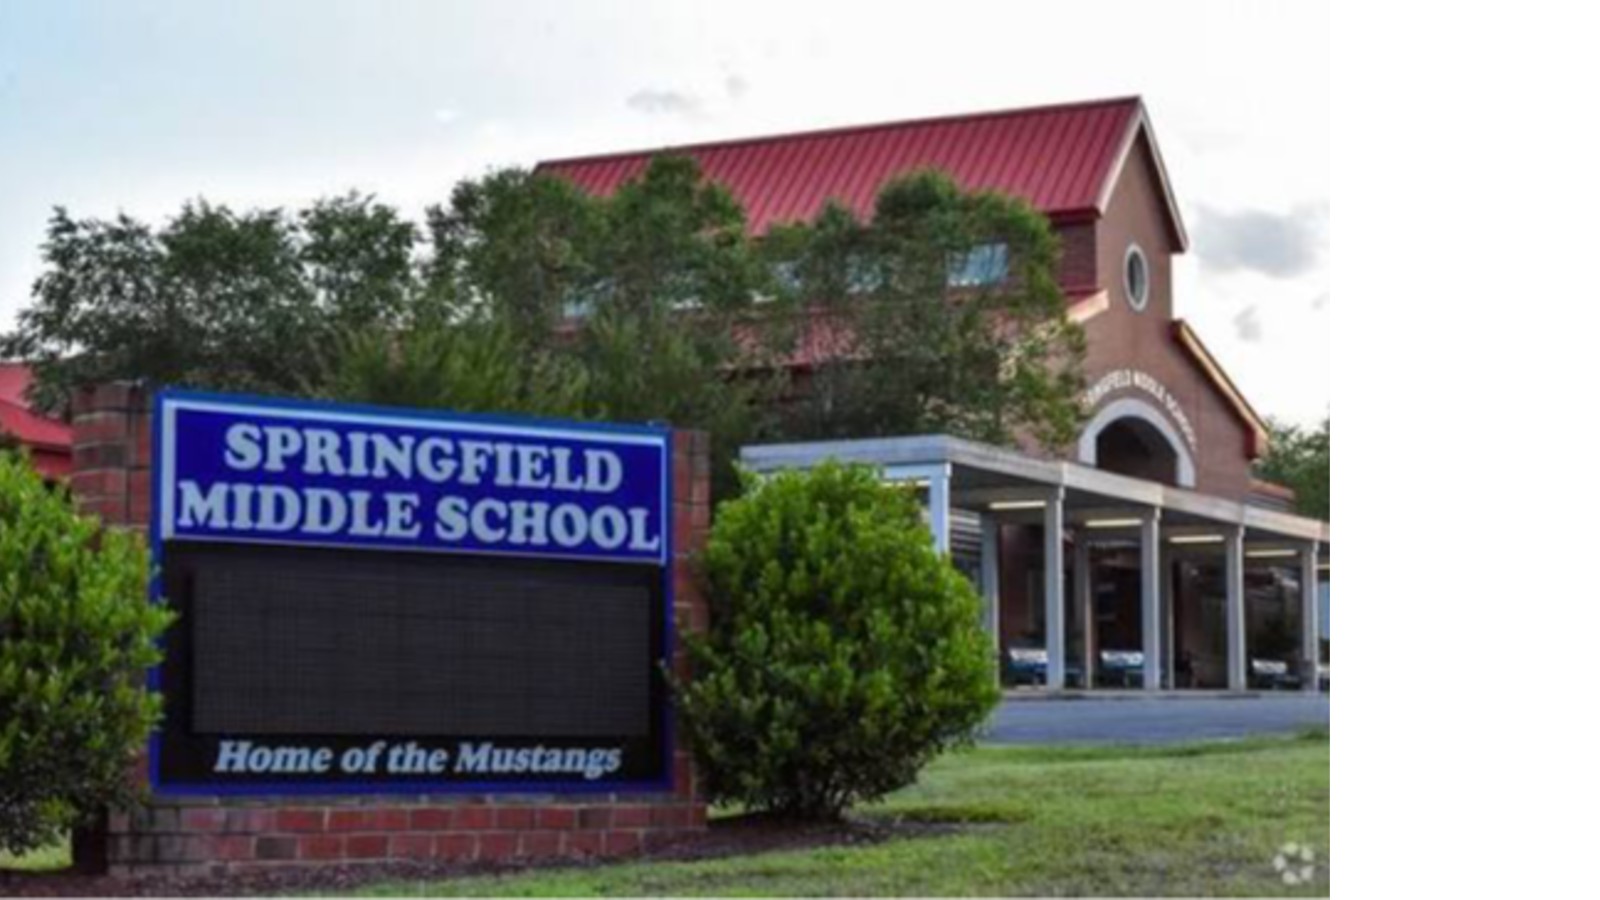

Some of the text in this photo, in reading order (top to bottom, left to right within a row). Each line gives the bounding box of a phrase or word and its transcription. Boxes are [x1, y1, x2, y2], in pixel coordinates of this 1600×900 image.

[224, 423, 623, 493] SPRINGFIELD
[177, 480, 660, 551] MIDDLE SCHOOL
[213, 740, 622, 779] Home of the Mustangs
